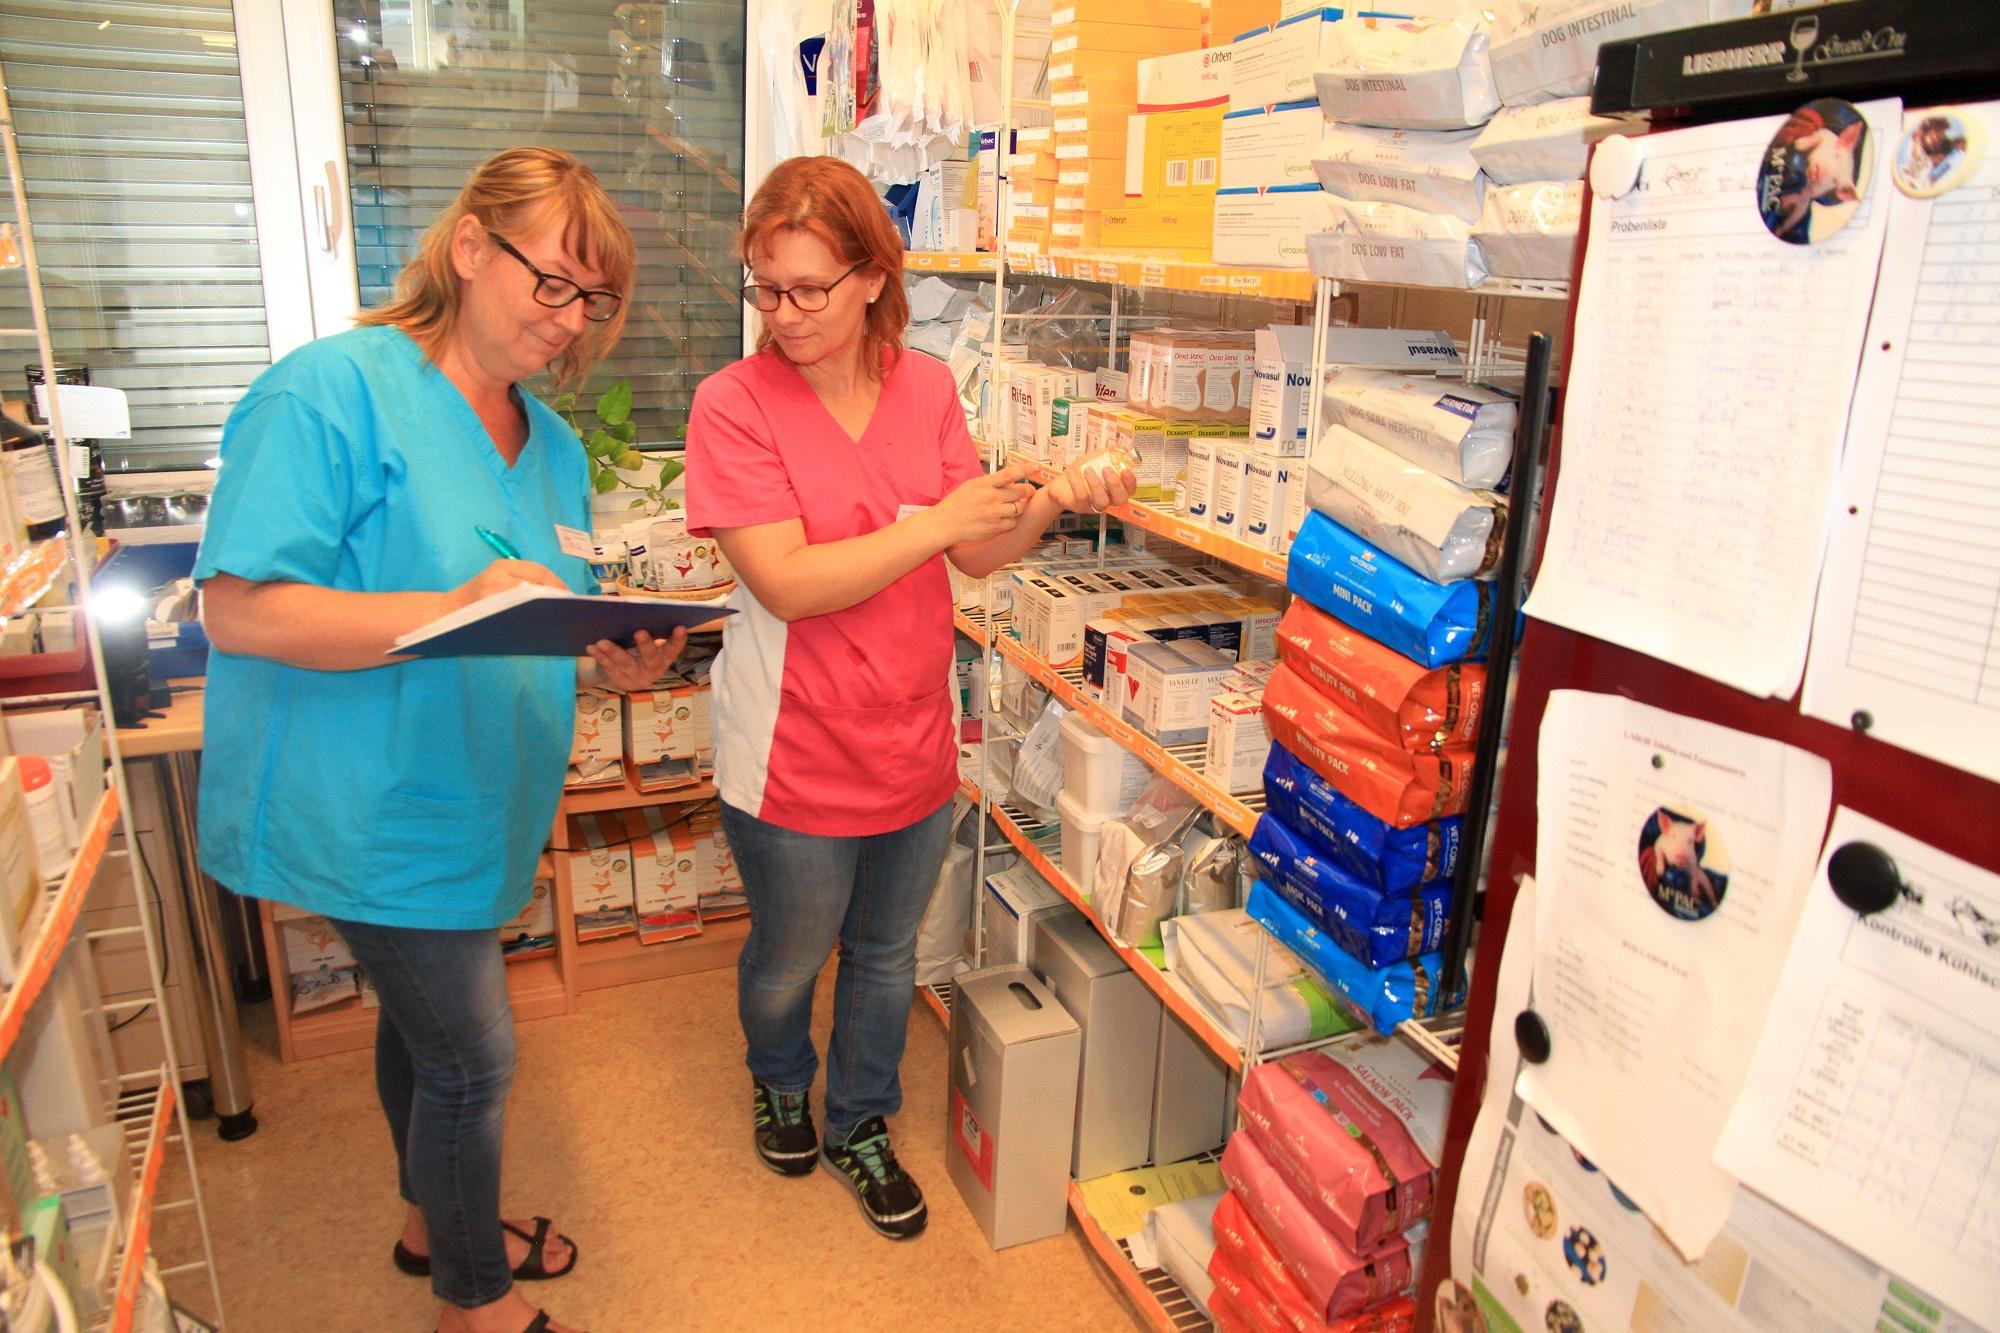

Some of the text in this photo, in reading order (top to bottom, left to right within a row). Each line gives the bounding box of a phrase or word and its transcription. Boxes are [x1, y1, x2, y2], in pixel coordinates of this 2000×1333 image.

[1541, 3, 1637, 48] DOG INTESTINAL
[1345, 78, 1407, 93] DOG INTESTINAL
[1358, 171, 1416, 193] DOG LOW FAT
[1610, 219, 1667, 234] Probenliste
[1351, 243, 1405, 259] DOG LOW FAT
[1408, 345, 1457, 357] Novasul
[1254, 369, 1280, 381] Novasul
[1011, 386, 1032, 406] Rifen
[1216, 455, 1239, 469] Novasul
[1247, 463, 1272, 478] Novasul
[1333, 584, 1373, 615] MINI PACK
[1309, 662, 1358, 701] VITALITY PACK
[1296, 731, 1349, 775] VITALITY PACK
[1858, 914, 1933, 955] Kontrolle
[1353, 1064, 1415, 1121] SALMON PACK
